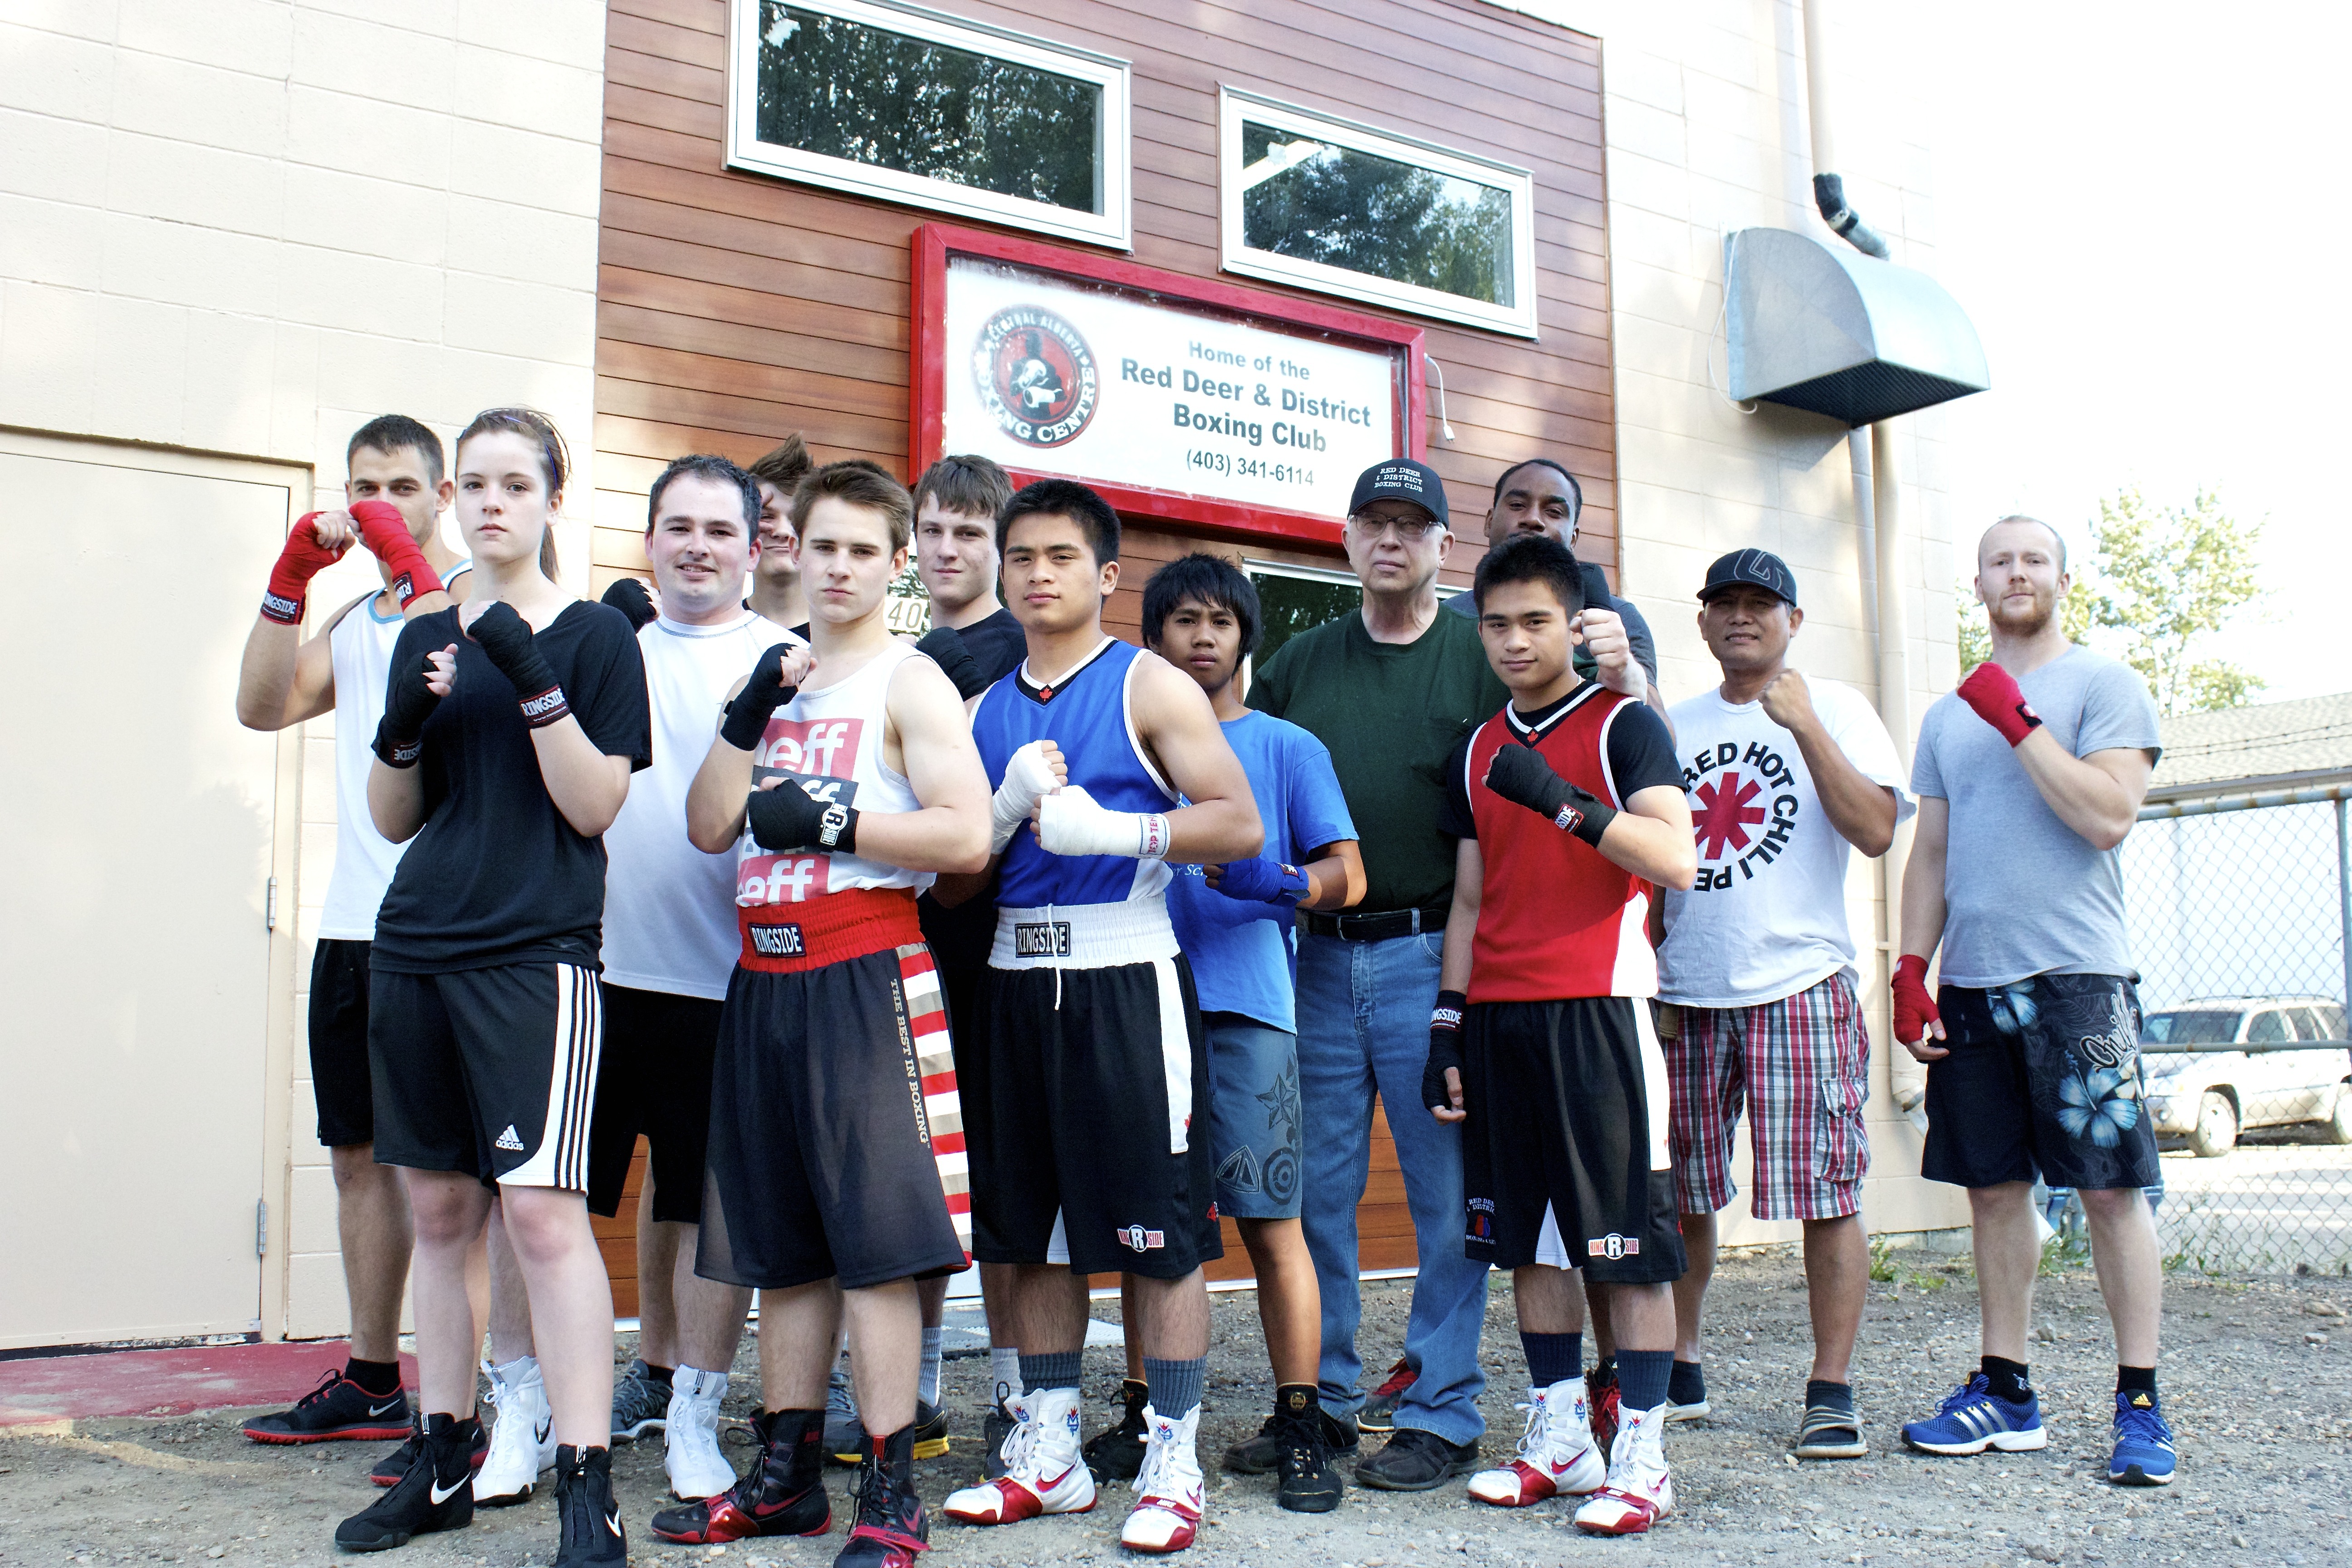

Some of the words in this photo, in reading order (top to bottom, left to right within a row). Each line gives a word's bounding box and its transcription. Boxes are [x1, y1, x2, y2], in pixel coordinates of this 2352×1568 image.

[1041, 316, 1083, 358] ALBERTA
[1189, 340, 1246, 368] Home
[1254, 356, 1272, 372] of
[1279, 360, 1310, 380] the
[1037, 367, 1096, 442] CENTRE
[1122, 358, 1172, 388] Red
[1183, 368, 1244, 402] Deer
[1254, 383, 1271, 407] &
[1282, 388, 1371, 427] District
[1174, 403, 1262, 447] Boxing
[1272, 422, 1326, 452] Club
[1186, 449, 1231, 477] (403)
[1237, 457, 1314, 486] 341-6114
[1383, 474, 1423, 485] DISTRICT
[1399, 467, 1421, 478] DEER
[1404, 483, 1423, 492] CLUB
[888, 601, 922, 629] 40
[520, 688, 565, 716] RINGSIDE
[1683, 742, 1738, 794] RED
[1743, 741, 1795, 789] HOT
[1738, 794, 1798, 880] CHILI
[751, 927, 802, 953] RINGSIDE
[1018, 926, 1065, 952] RINGSIDE
[891, 979, 903, 1012] THE
[897, 1015, 911, 1056] BEST
[905, 1059, 916, 1078] IN
[909, 1081, 929, 1143] BOXING
[496, 1139, 524, 1151] adidas
[1147, 1232, 1162, 1245] SIDE
[1590, 1240, 1603, 1253] RING
[1607, 1236, 1621, 1256] R
[1625, 1240, 1637, 1252] SIDE
[1156, 1499, 1176, 1509] NIKE
